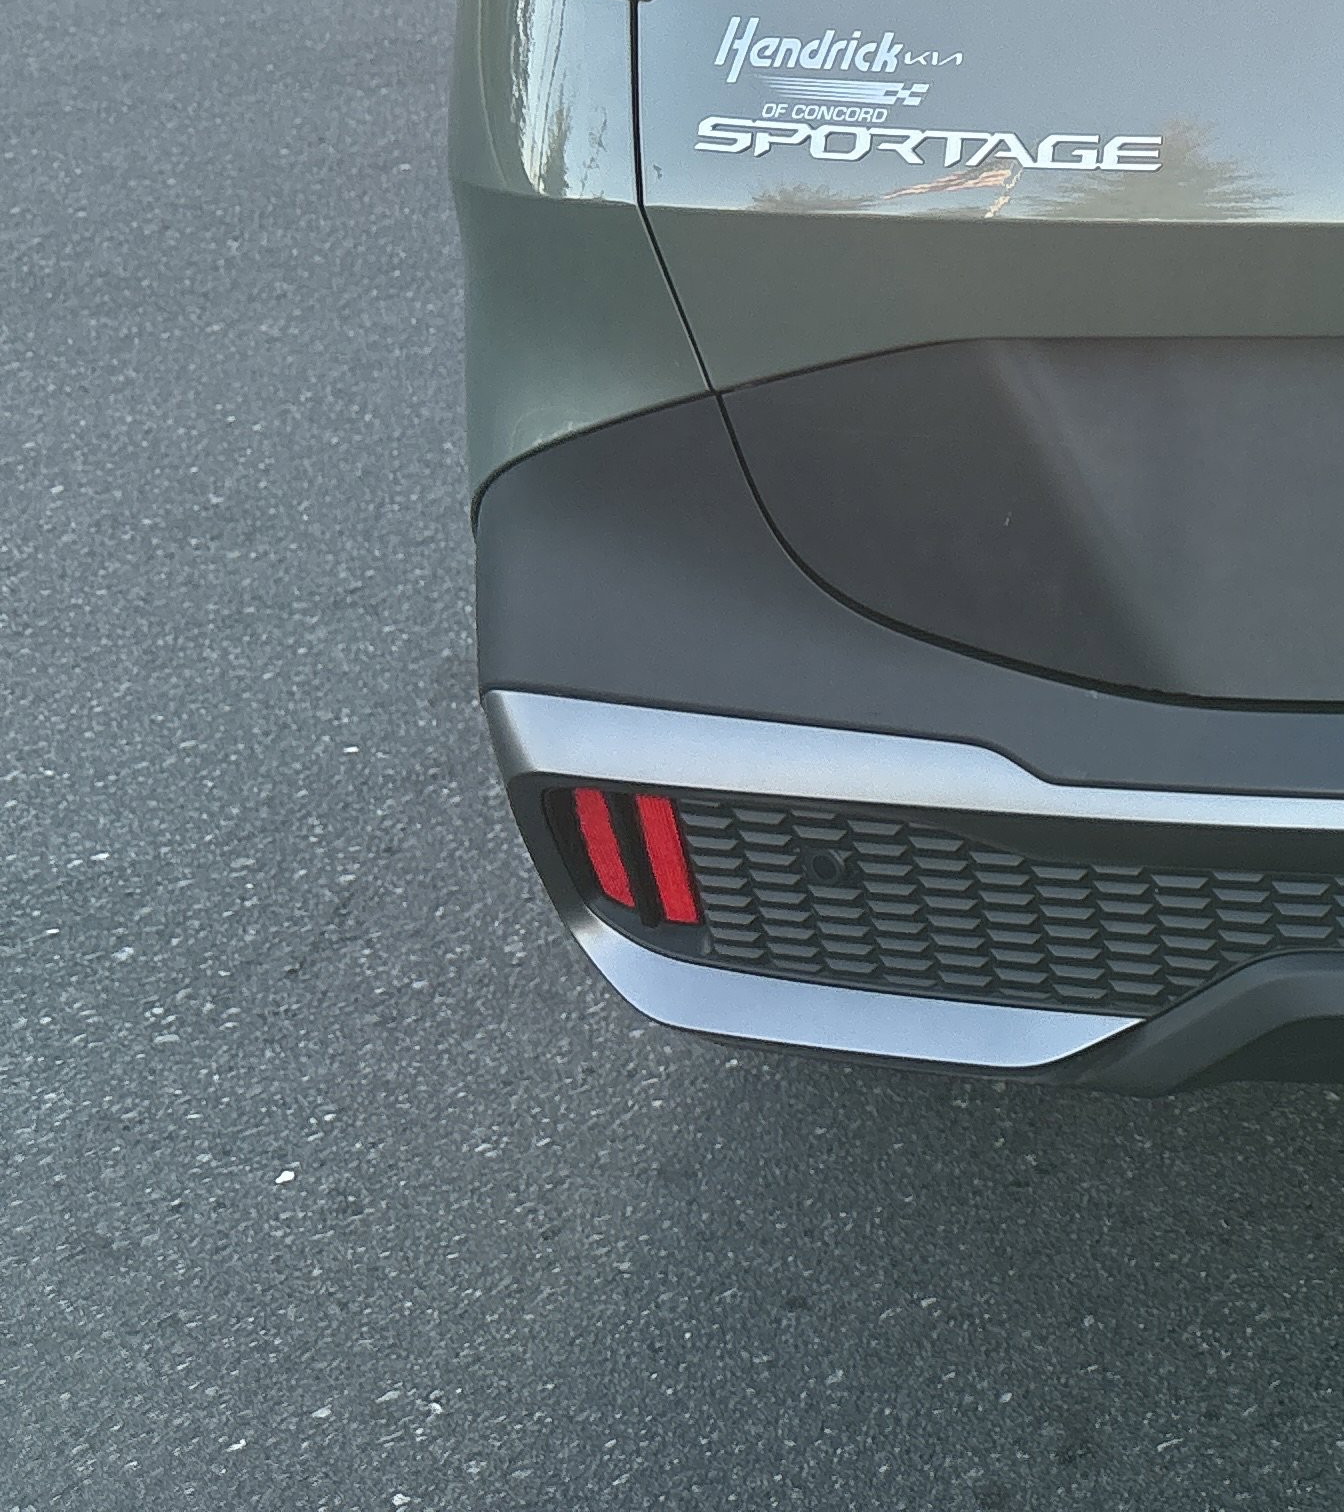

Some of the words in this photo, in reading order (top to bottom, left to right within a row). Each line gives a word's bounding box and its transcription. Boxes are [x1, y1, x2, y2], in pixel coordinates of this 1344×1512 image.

[714, 16, 904, 83] Hendrick
[762, 103, 788, 119] OF
[791, 104, 889, 123] CONCORD
[694, 115, 1164, 172] SPORTAGE
